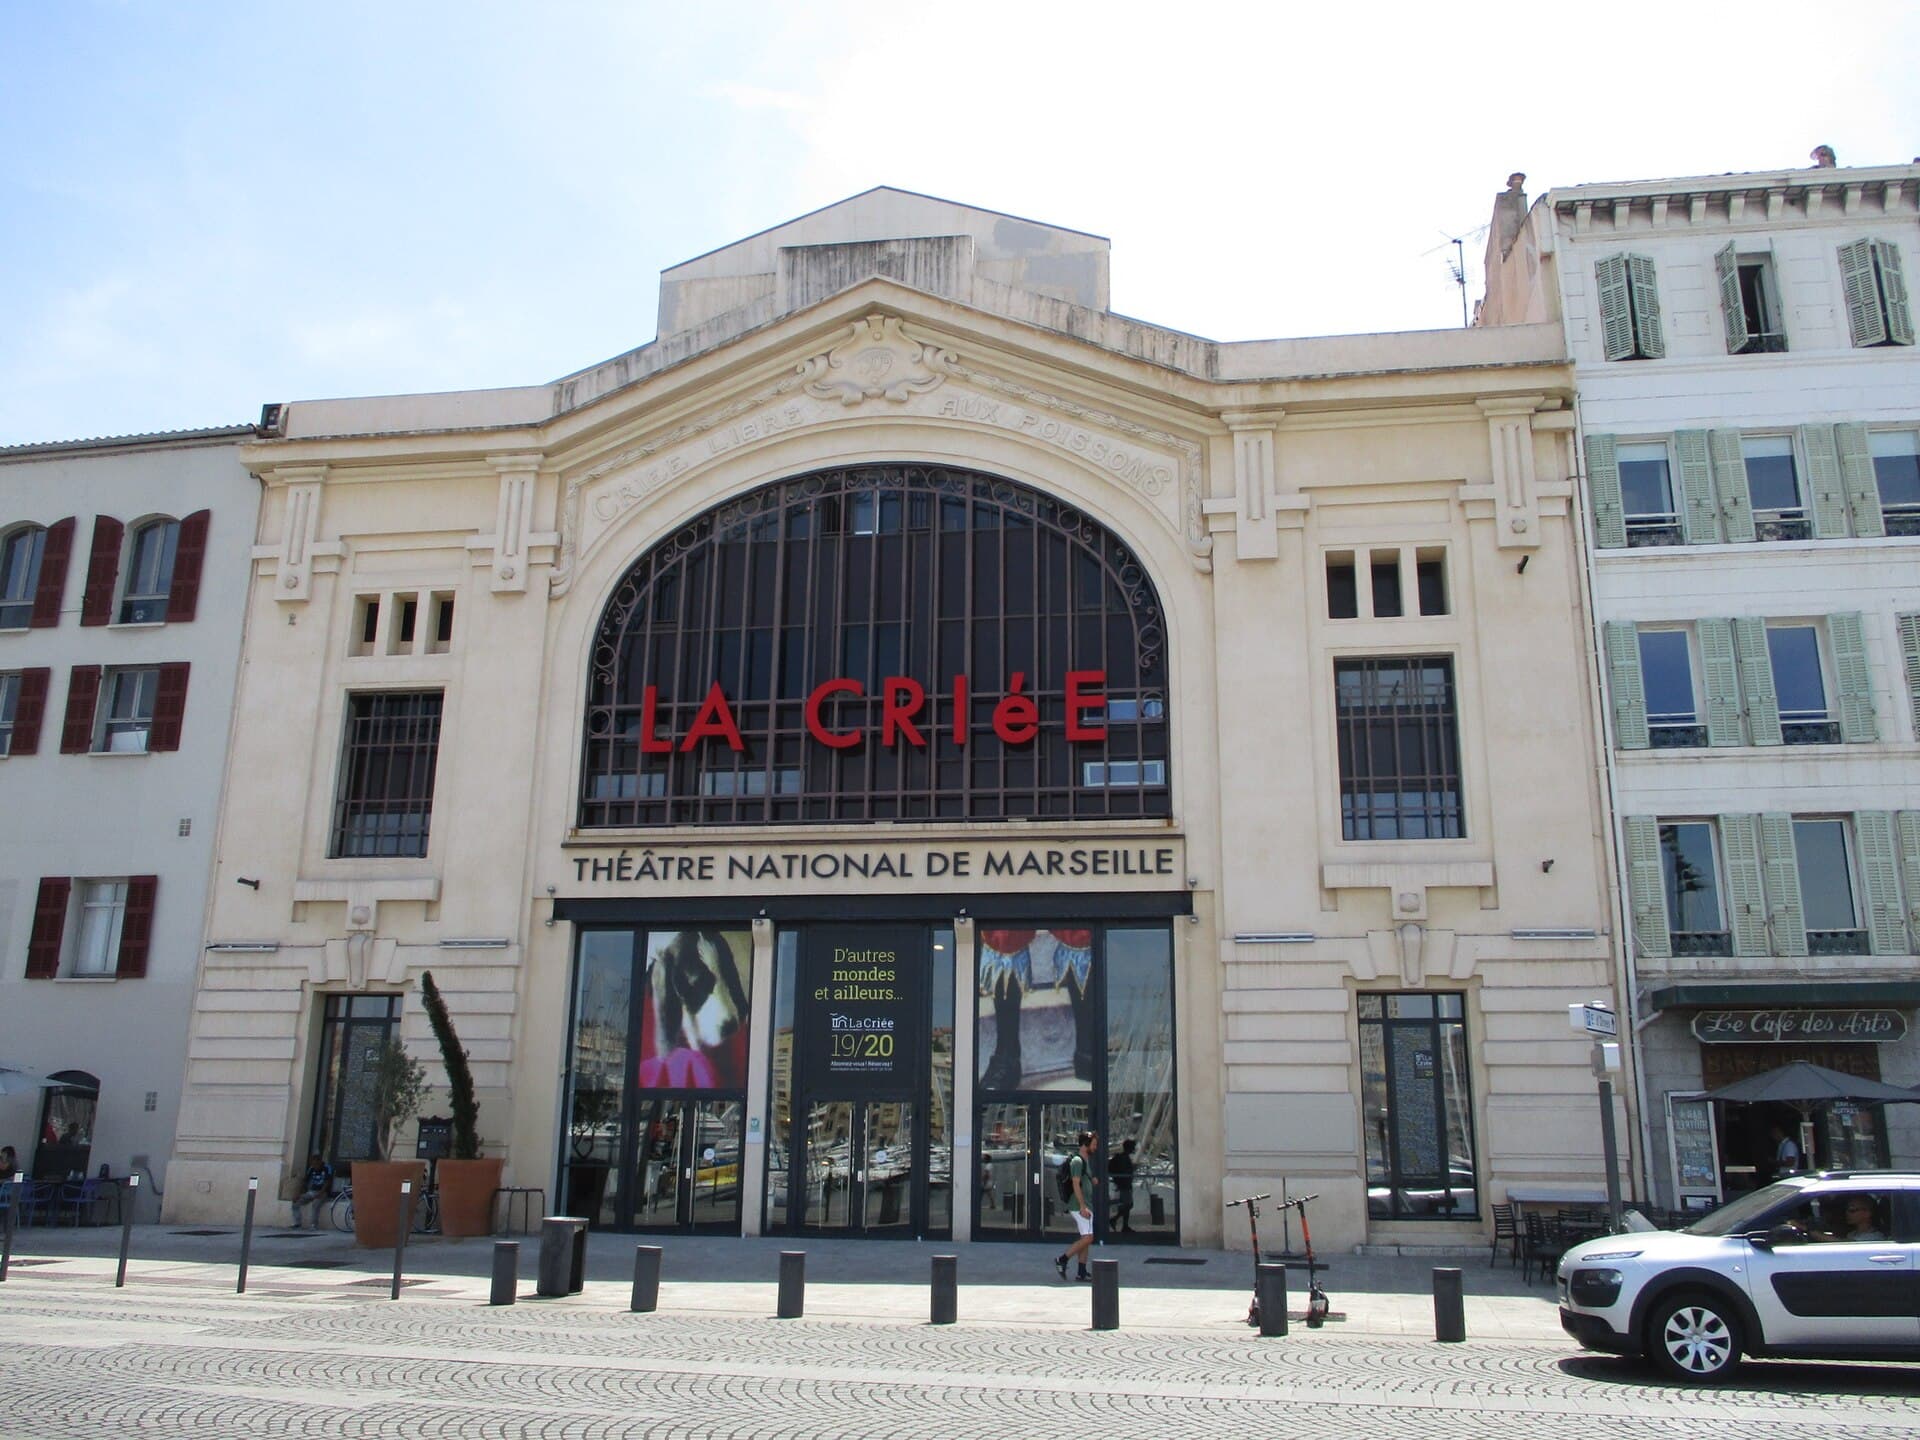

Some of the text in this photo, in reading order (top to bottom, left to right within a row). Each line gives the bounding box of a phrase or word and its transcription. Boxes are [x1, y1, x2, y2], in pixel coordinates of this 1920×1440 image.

[707, 407, 804, 455] LIBRE
[938, 397, 1000, 424] AUX
[1018, 414, 1172, 496] POISSONS
[642, 671, 1106, 752] LA CRIéE
[573, 849, 1173, 882] THÉÂTRE NATIONAL DE MARSEILLE
[834, 949, 896, 963] D'autres
[832, 967, 896, 981] mondes
[814, 985, 904, 1001] et ailleurs...
[1706, 1011, 1892, 1041] Le Café des Arts
[831, 1034, 894, 1058] 19/20
